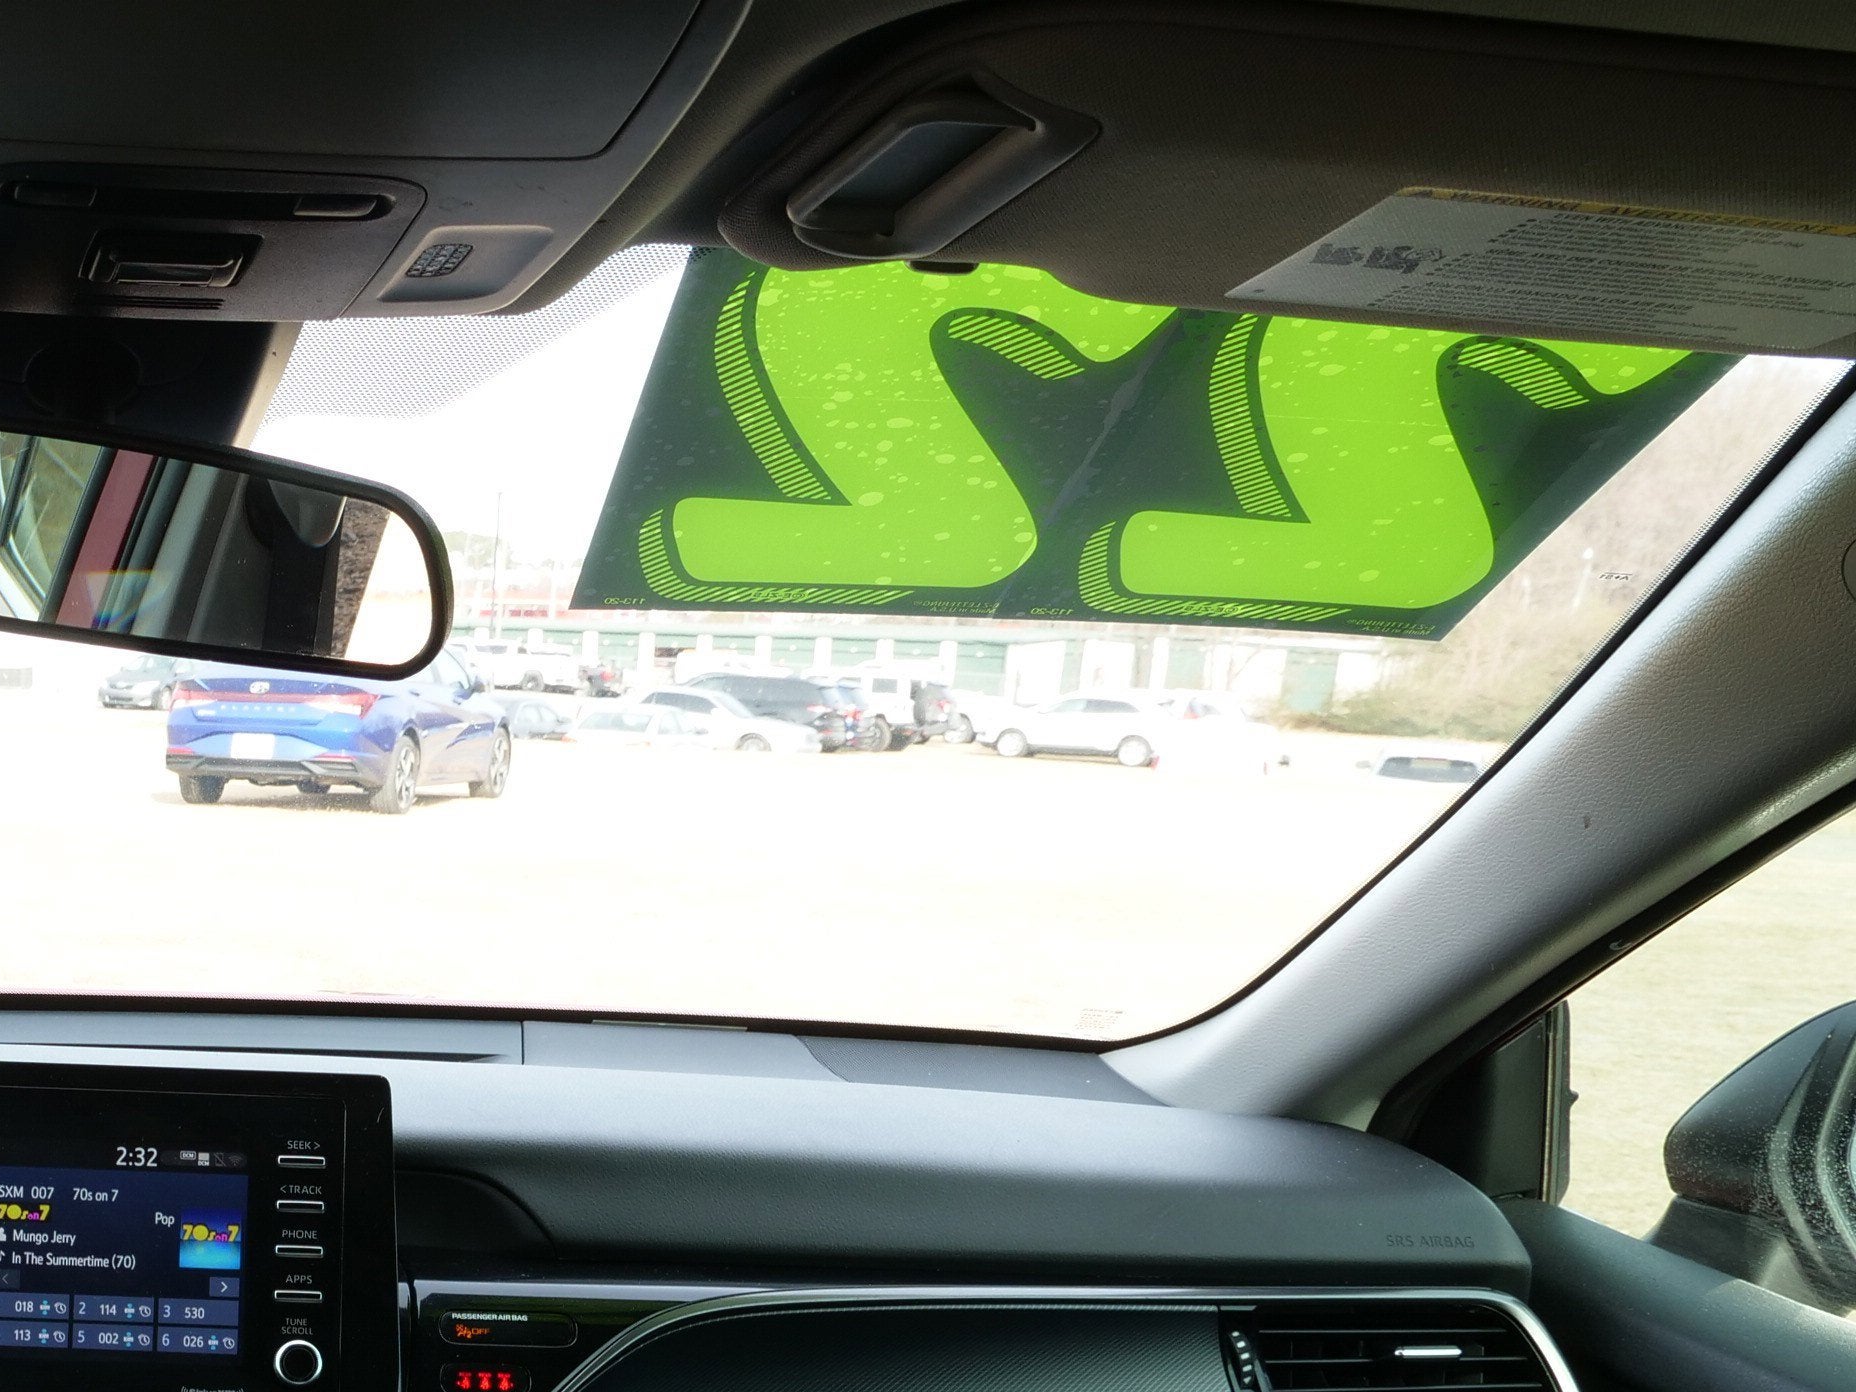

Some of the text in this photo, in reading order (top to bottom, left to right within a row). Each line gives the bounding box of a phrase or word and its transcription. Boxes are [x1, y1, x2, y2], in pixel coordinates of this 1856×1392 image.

[287, 1140, 312, 1150] SEEK
[115, 1146, 158, 1168] 2:32
[31, 1186, 55, 1200] 007
[72, 1188, 93, 1202] 70s
[95, 1191, 109, 1202] on
[111, 1189, 119, 1202] 7
[289, 1185, 322, 1195] TRACK
[154, 1212, 175, 1227] Pop
[13, 1230, 76, 1247] Mungo Jerry
[281, 1229, 318, 1240] PHONE
[1386, 1234, 1476, 1249] SRS AIRBAG
[11, 1252, 136, 1270] In The Summertime (70)
[285, 1274, 313, 1285] APPS
[14, 1301, 34, 1313] 018
[79, 1302, 117, 1316] 2 114
[163, 1305, 205, 1319] 3 530
[285, 1317, 308, 1326] TUNE
[451, 1312, 498, 1321] PASSENGER
[511, 1313, 528, 1322] BAG
[13, 1329, 31, 1341] 113
[281, 1326, 314, 1335] SCROLL
[77, 1331, 119, 1345] 5 002
[162, 1334, 204, 1348] 6 026
